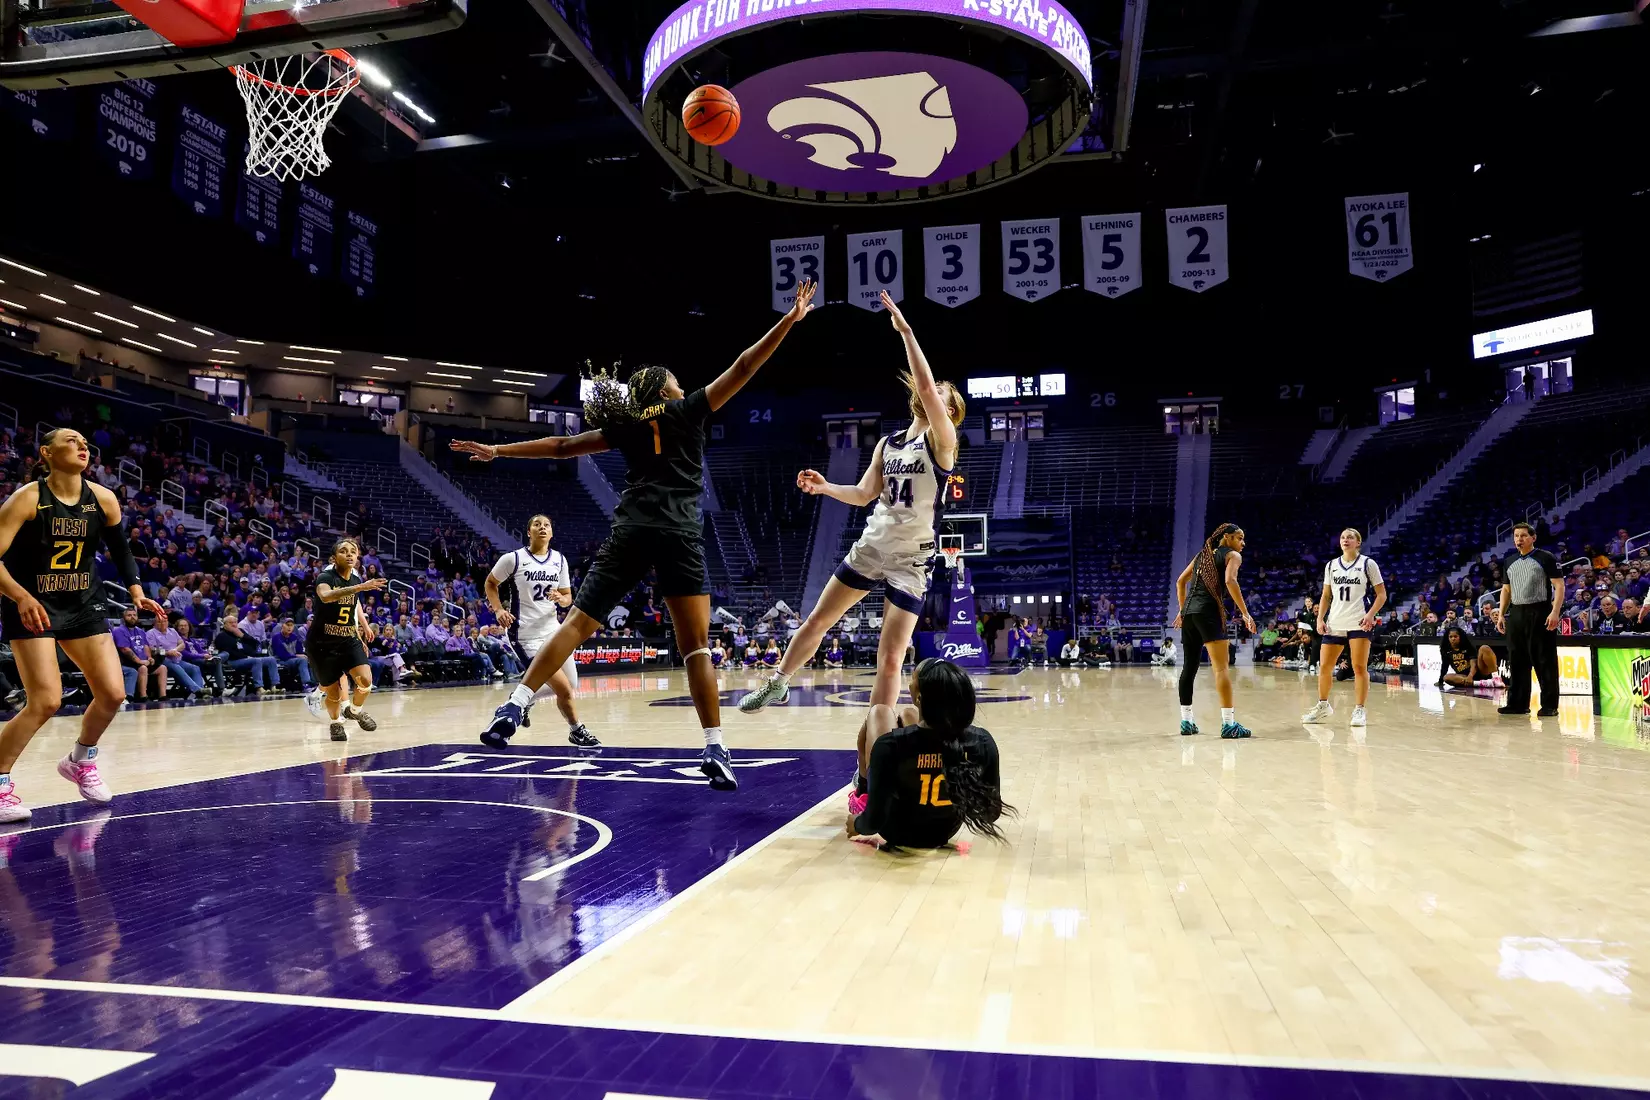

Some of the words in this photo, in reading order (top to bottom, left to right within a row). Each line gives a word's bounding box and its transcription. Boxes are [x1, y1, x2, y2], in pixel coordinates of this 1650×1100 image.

[664, 5, 701, 61] DUNK
[114, 88, 131, 105] BIG
[133, 100, 144, 113] 12
[101, 93, 156, 131] CONFERENCE
[100, 104, 156, 142] CHAMPIONS
[181, 105, 227, 140] K-STATE
[107, 128, 146, 161] 2019
[185, 150, 199, 162] 1917
[300, 182, 334, 209] K-STATE
[1349, 202, 1385, 212] AYOKA
[1387, 200, 1406, 210] LEE
[348, 209, 378, 233] K-STATE
[1089, 220, 1133, 231] LEHNING
[1169, 212, 1225, 224] CHAMBERS
[935, 232, 969, 241] OHLDE
[1011, 225, 1050, 235] WECKER
[1355, 212, 1398, 248] 61
[775, 242, 820, 254] ROMSTAD
[861, 237, 888, 248] GARY
[1186, 226, 1211, 264] 2
[1008, 238, 1055, 275] 53
[1101, 234, 1124, 270] 5
[853, 249, 898, 286] 10
[941, 244, 964, 280] 3
[1363, 260, 1399, 268] 1/23/2022
[775, 254, 820, 291] 33
[1096, 275, 1130, 284] 2005-09
[1182, 268, 1216, 278] 2009-13
[936, 285, 969, 294] 2000-04
[1016, 279, 1048, 288] 2001-05
[996, 383, 1011, 394] 50
[1045, 381, 1058, 391] 51
[1279, 384, 1305, 399] 27
[1090, 392, 1117, 407] 26
[749, 409, 772, 424] 24
[649, 420, 661, 454] 1
[888, 476, 914, 508] 34
[52, 517, 88, 537] WEST
[50, 541, 85, 570] 21
[1339, 586, 1351, 601] 11
[337, 607, 351, 624] 5
